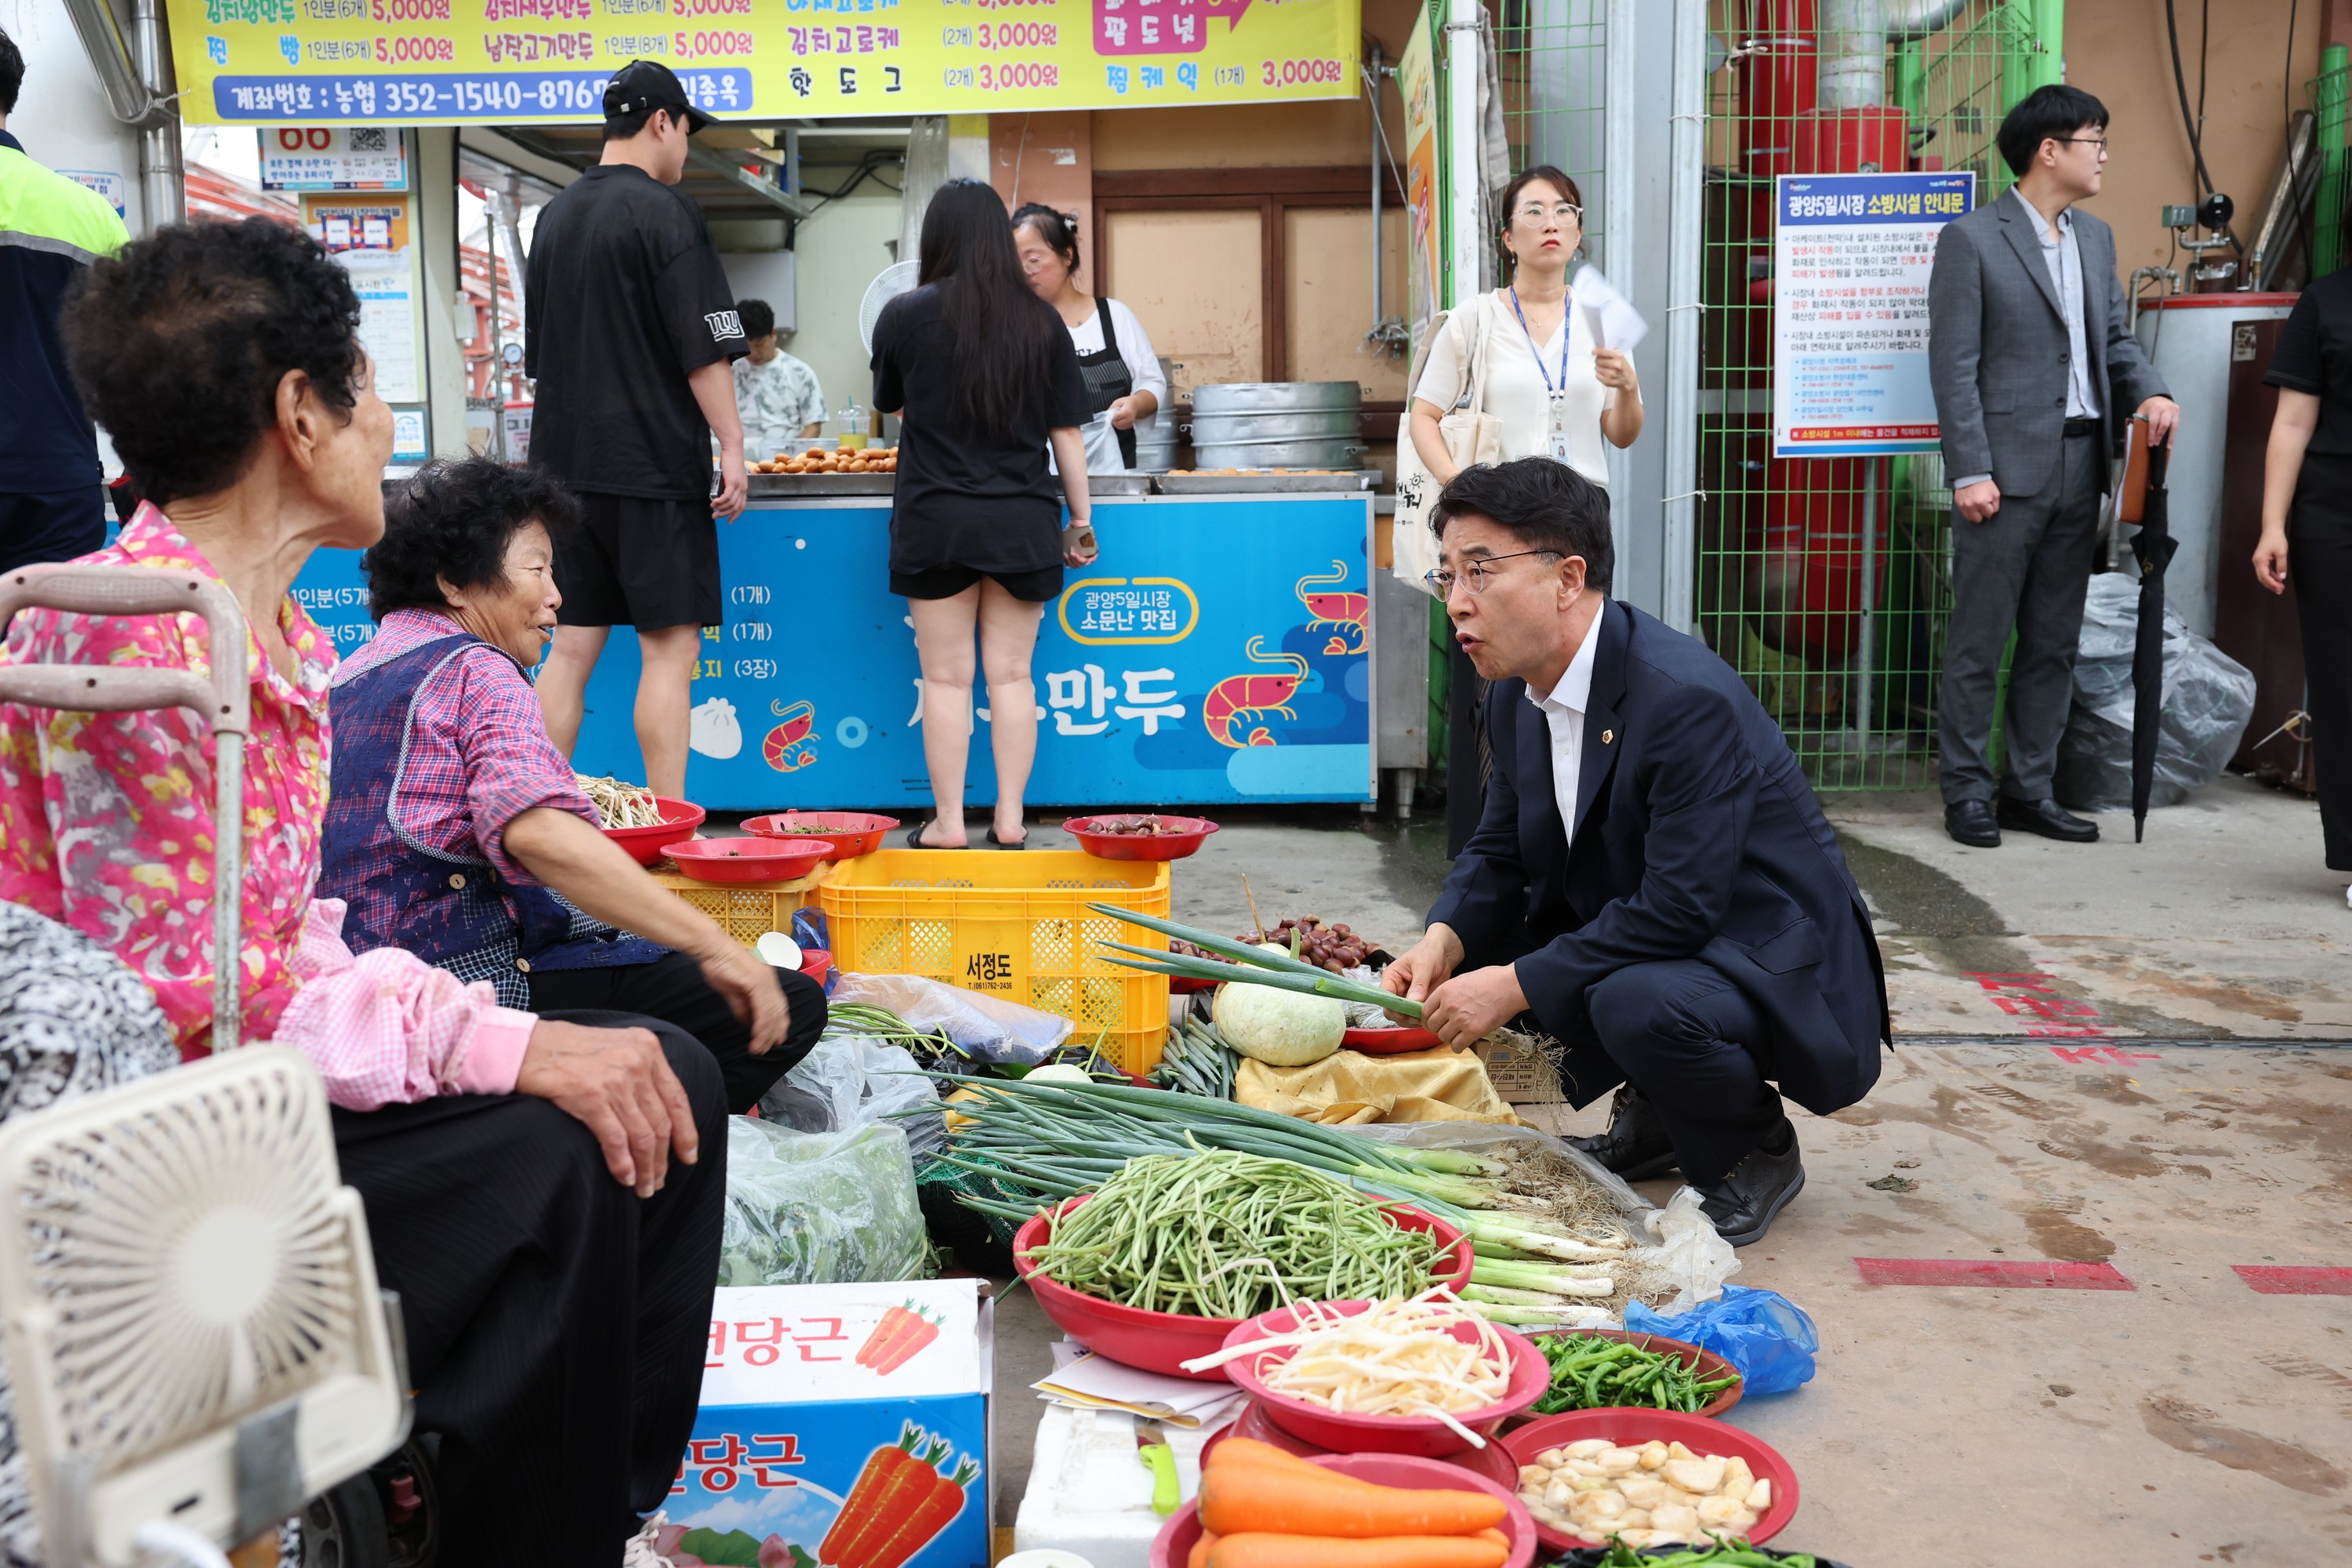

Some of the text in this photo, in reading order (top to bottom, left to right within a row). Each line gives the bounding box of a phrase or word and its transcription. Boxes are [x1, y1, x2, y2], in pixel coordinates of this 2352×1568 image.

[304, 0, 368, 20] 1인분(6개)
[373, 0, 451, 24] 5,000원
[485, 32, 753, 63] 납작고기만두 1인분(8개) 5,000원
[788, 23, 1057, 56] 김치고로케 (2개) 3,000원
[307, 41, 371, 61] 1인분(6개)
[376, 38, 454, 65] 5,000원
[944, 67, 974, 88] (2개)
[980, 64, 1058, 92] 3,000원
[1215, 66, 1245, 86] (1개)
[1262, 60, 1342, 88] 3,000원
[231, 82, 314, 114] 계좌번호
[335, 80, 376, 115] 농협
[1788, 192, 1965, 217] 광양5일시장 소방시설 안내문
[1883, 231, 1923, 242] 소방시설은
[1792, 245, 1816, 256] 발생시
[1819, 245, 1842, 255] 작동이
[1846, 244, 1867, 253] 되므로
[1871, 244, 1911, 253] 시장내에서
[1792, 257, 1816, 267] 화재로
[1819, 257, 1851, 267] 인식하고
[1854, 256, 1878, 266] 작동이
[1882, 256, 1897, 265] 되면
[1792, 270, 1816, 278] 피해가
[1854, 267, 1906, 278] 알려드립니다.
[1791, 289, 1815, 298] 시장내
[1818, 288, 1857, 297] 소방시설을
[1886, 286, 1926, 296] 조작하거나
[1792, 300, 1809, 310] 경우
[1812, 299, 1837, 309] 화재시
[1841, 299, 1865, 308] 작동이
[1869, 299, 1886, 307] 되지
[1909, 298, 1929, 307] 막대
[1819, 311, 1842, 321] 피해를
[1865, 310, 1873, 319] 수
[1791, 331, 1813, 340] 시장내
[1817, 330, 1853, 340] 소방시설이
[1896, 329, 1911, 338] 화재
[1791, 340, 1924, 351] 아래 연락처로 알려주시기 바랍니다.
[731, 586, 771, 605] (1개)
[1085, 590, 1171, 610] 광양5일시장
[1080, 609, 1176, 631] 소문난 맛집
[733, 622, 772, 641] (1개)
[735, 659, 777, 679] (3장)
[967, 953, 1012, 980] 서정도
[670, 1434, 804, 1494] 당근
